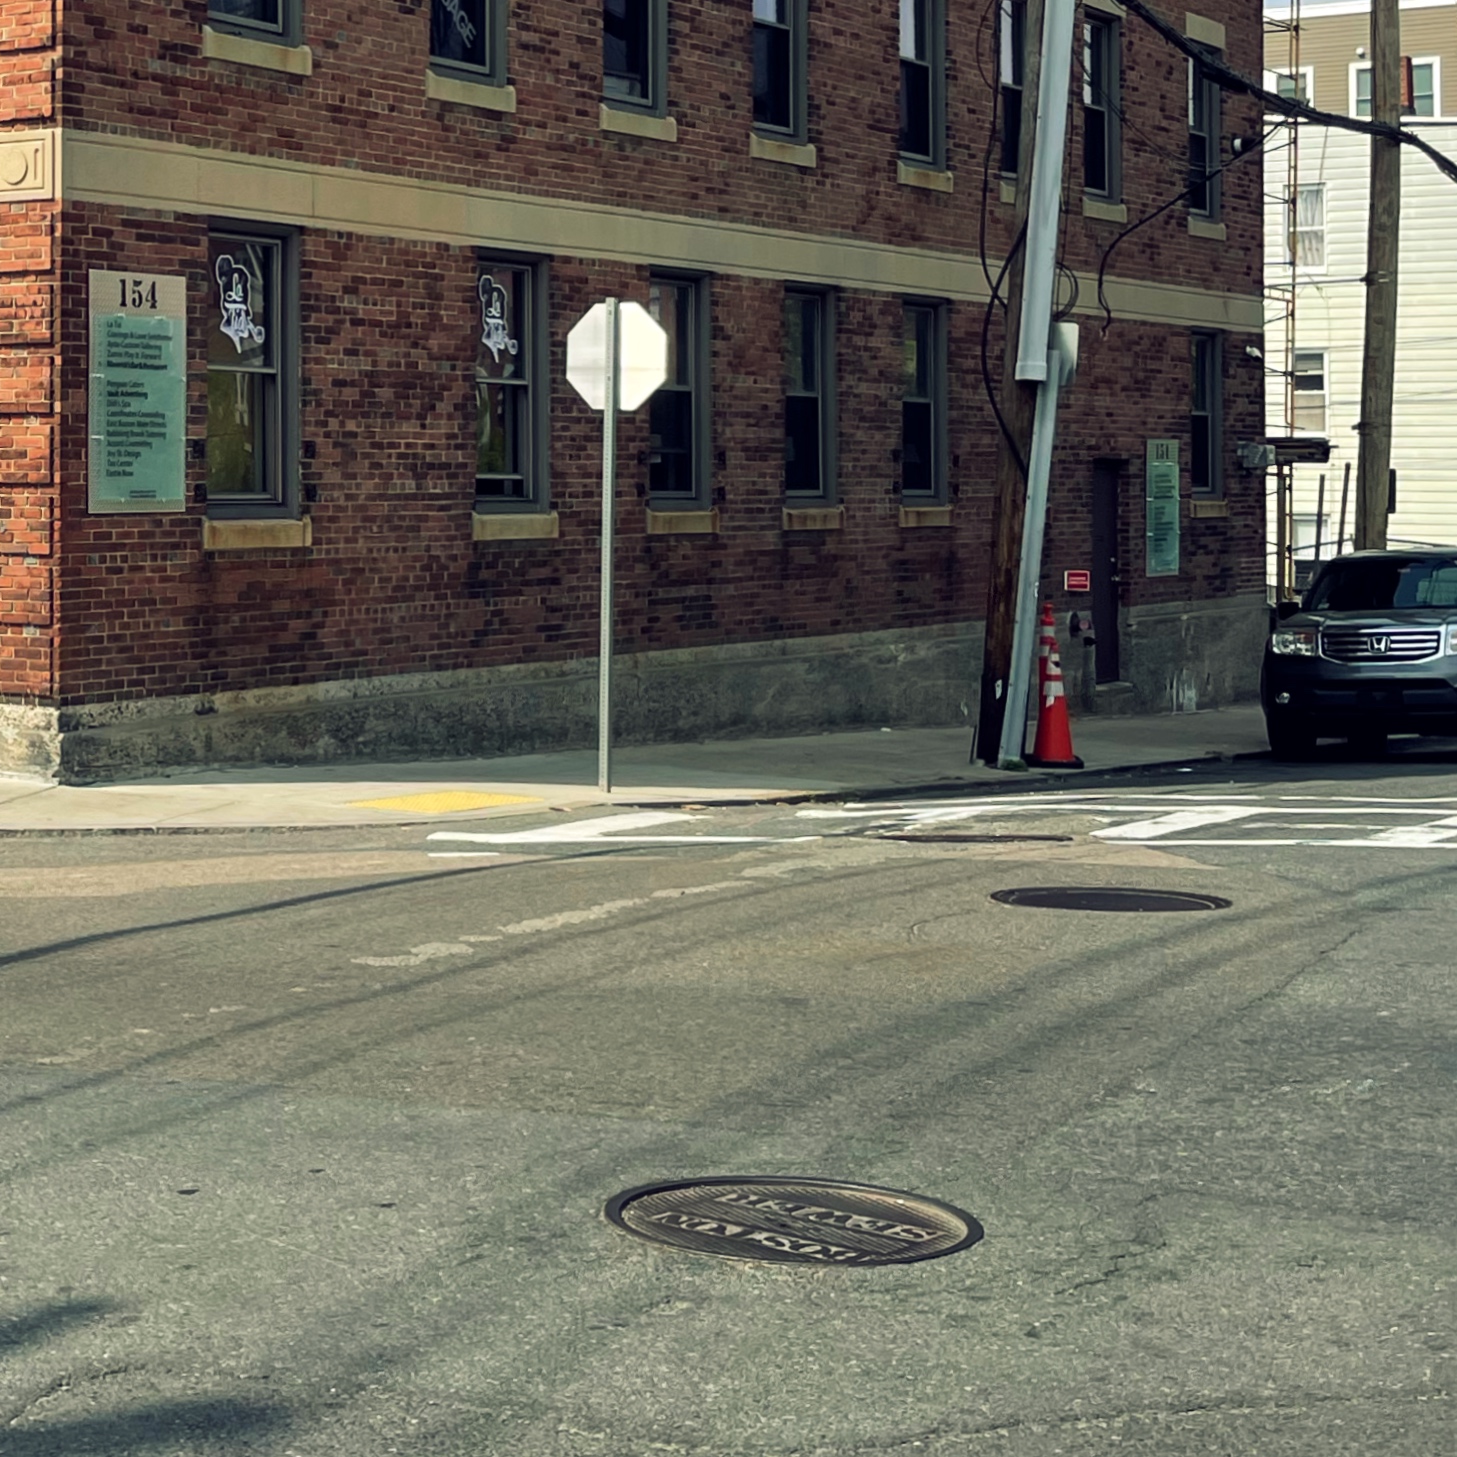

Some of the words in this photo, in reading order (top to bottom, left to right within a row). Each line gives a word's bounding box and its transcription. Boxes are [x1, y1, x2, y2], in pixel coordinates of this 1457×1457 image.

[119, 278, 158, 310] 154
[225, 273, 243, 301] La
[486, 292, 501, 317] La
